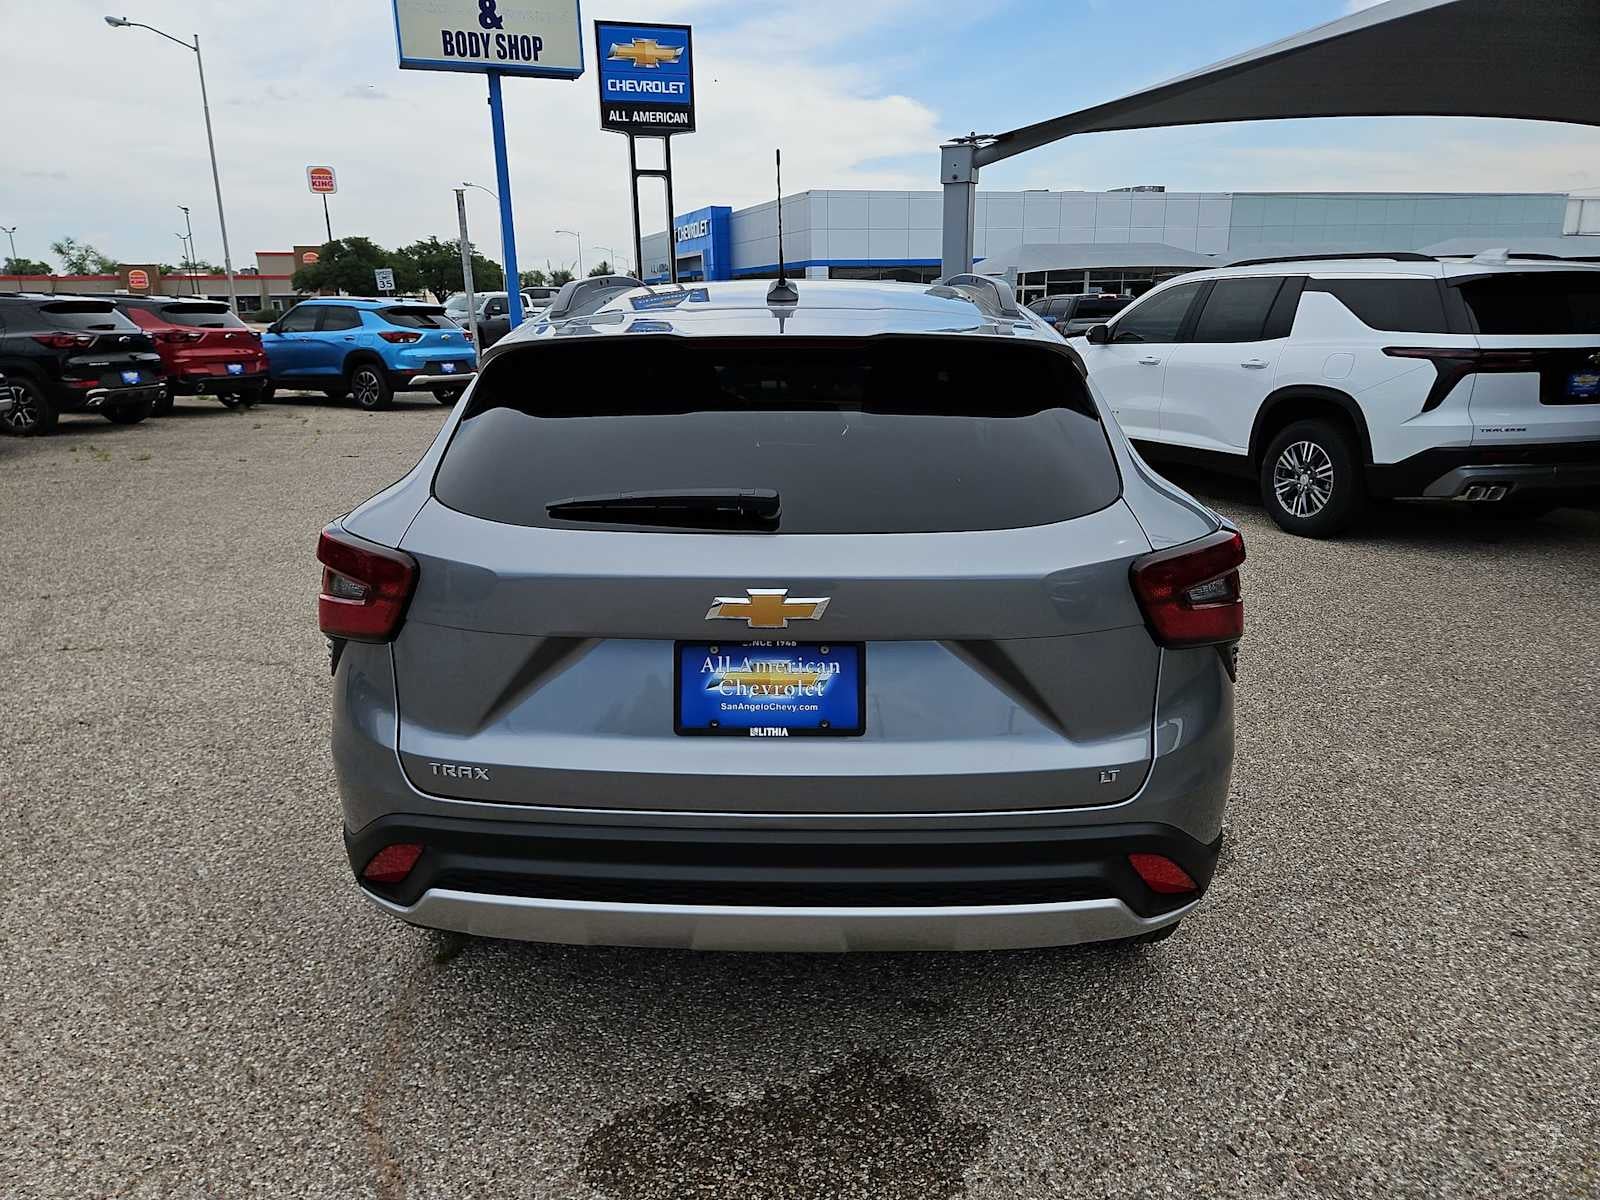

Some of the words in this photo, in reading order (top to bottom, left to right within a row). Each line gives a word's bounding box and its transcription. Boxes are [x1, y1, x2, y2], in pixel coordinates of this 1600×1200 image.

[478, 0, 504, 29] &
[441, 30, 491, 59] BODY
[495, 33, 544, 62] SHOP
[607, 79, 686, 95] CHEVROLET
[608, 109, 630, 123] ALL
[631, 110, 689, 124] AMERICAN
[677, 220, 711, 242] CHEVROLET
[379, 280, 392, 288] 35
[700, 655, 731, 673] All
[739, 655, 841, 674] American
[718, 679, 825, 697] Chevrolet
[720, 702, 819, 713] SanAngeloChevy.com
[757, 727, 789, 737] LITHIA
[429, 762, 491, 781] TRAX
[1100, 769, 1121, 784] LT
